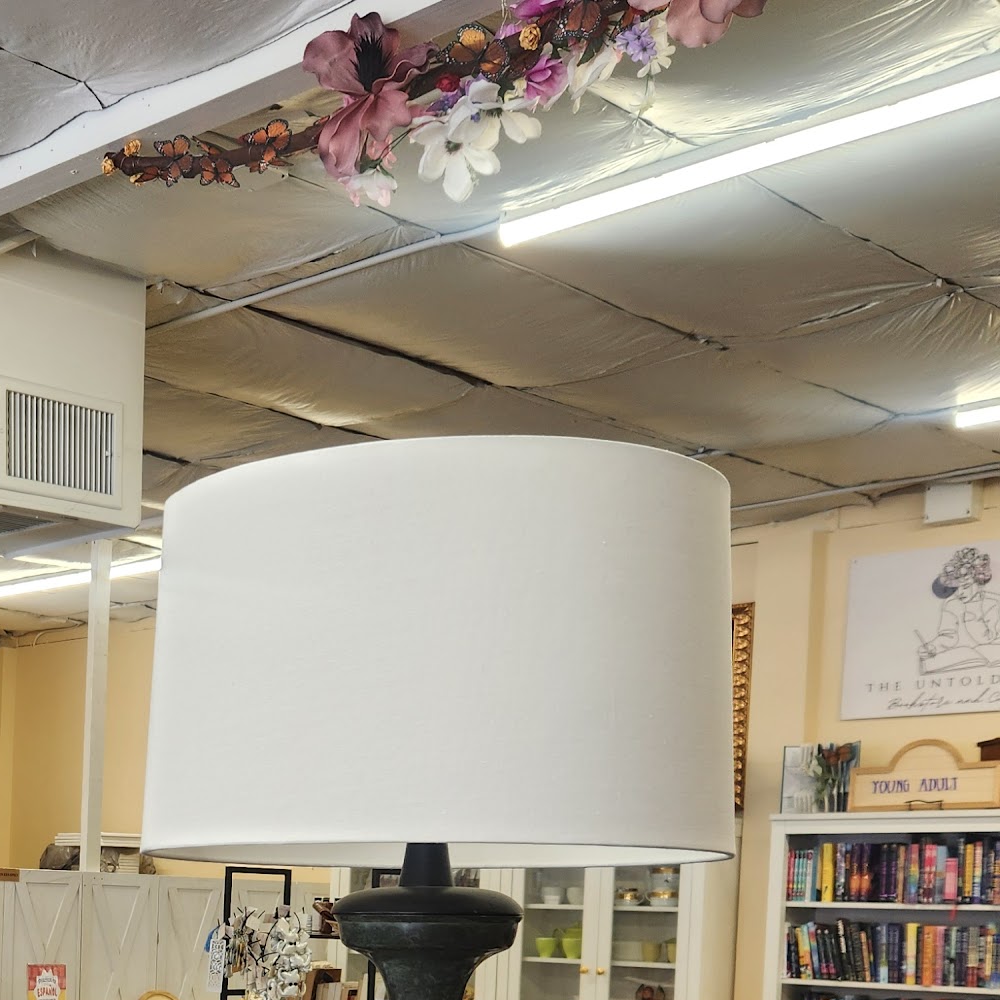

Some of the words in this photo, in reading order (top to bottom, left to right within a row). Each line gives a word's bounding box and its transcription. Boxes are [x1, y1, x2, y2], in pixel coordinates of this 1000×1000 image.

[866, 681, 902, 693] THE
[916, 674, 1000, 690] UNTOLD
[871, 779, 911, 794] YOUNG
[919, 777, 958, 792] ADULT
